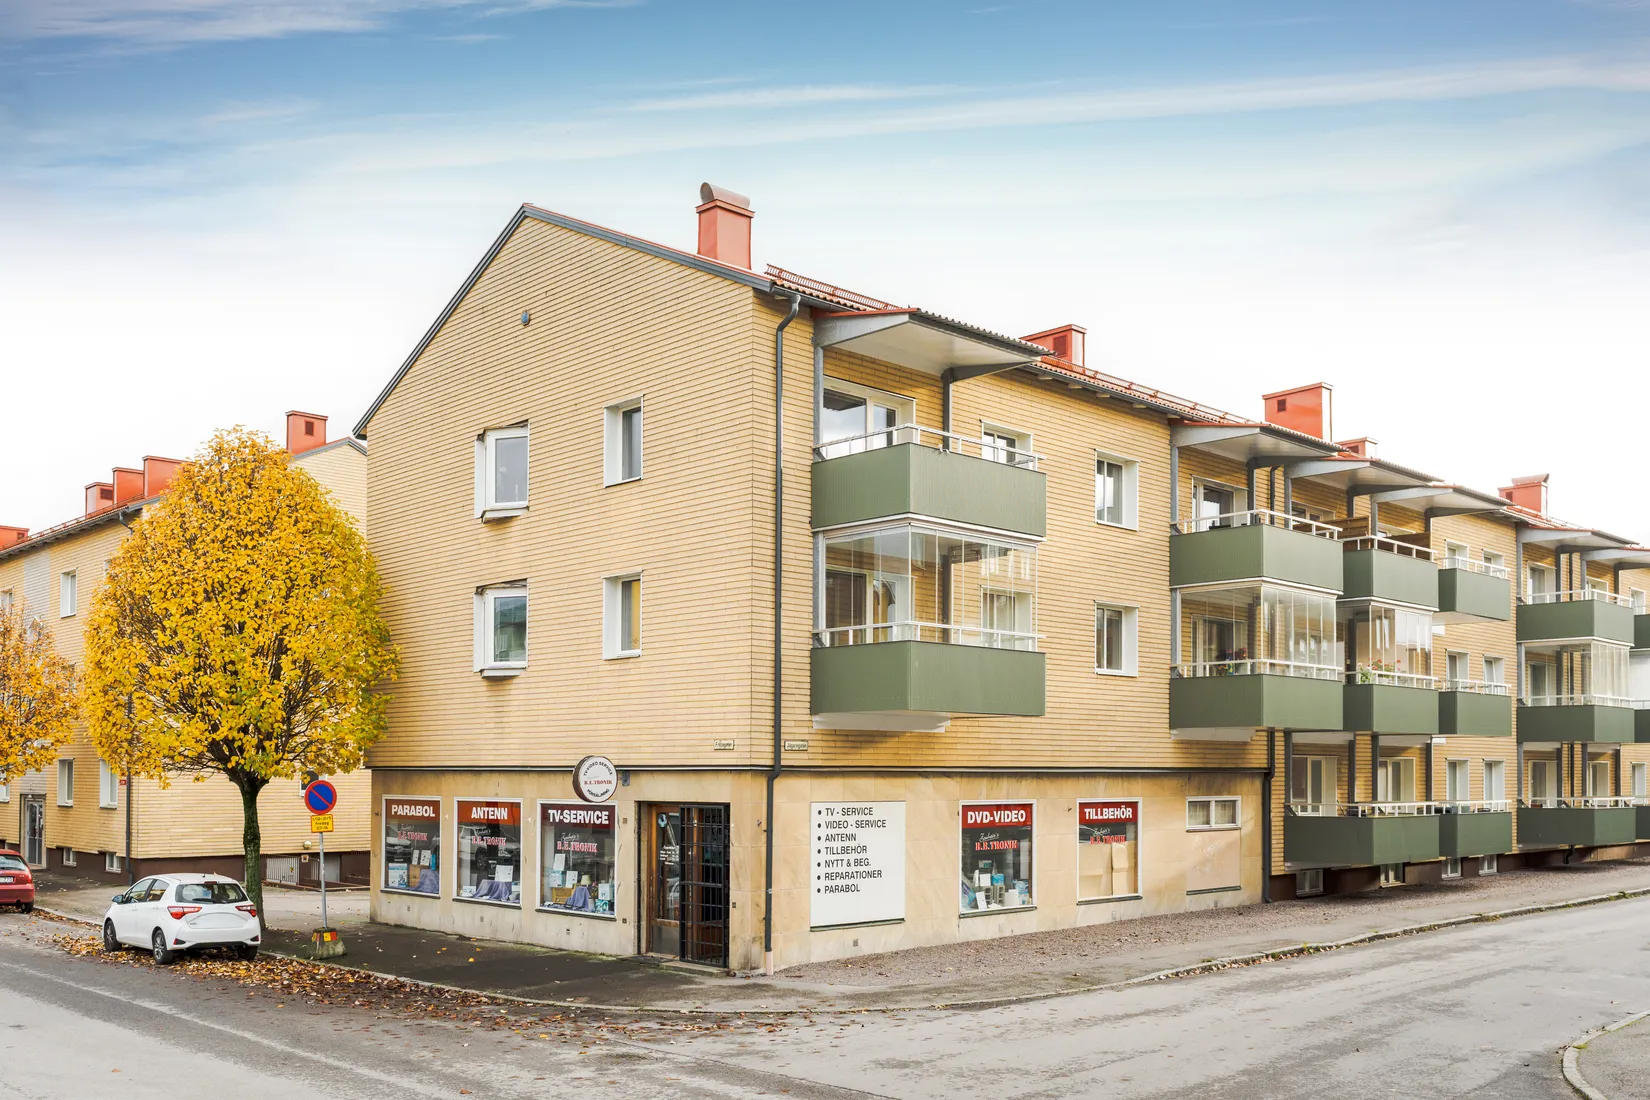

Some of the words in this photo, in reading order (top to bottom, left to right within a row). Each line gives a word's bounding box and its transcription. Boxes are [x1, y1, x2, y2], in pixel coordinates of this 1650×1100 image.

[391, 804, 436, 817] PARABOL
[471, 806, 508, 820] ANTENN
[841, 807, 874, 816] SERVICE
[1084, 805, 1133, 820] TILLBEHÖR
[548, 809, 609, 825] TV-SERVICE
[967, 810, 1026, 824] DVD-VIDEO
[825, 820, 849, 829] VIDEO
[855, 819, 887, 829] SERVICE
[825, 834, 856, 842] ANTENN
[825, 844, 867, 855] TILLBEHÖR
[825, 859, 844, 868] NYTT
[846, 858, 851, 867] &
[853, 858, 871, 867] BEG.
[824, 870, 882, 881] REPARATIONER
[824, 884, 860, 894] PARABOL
